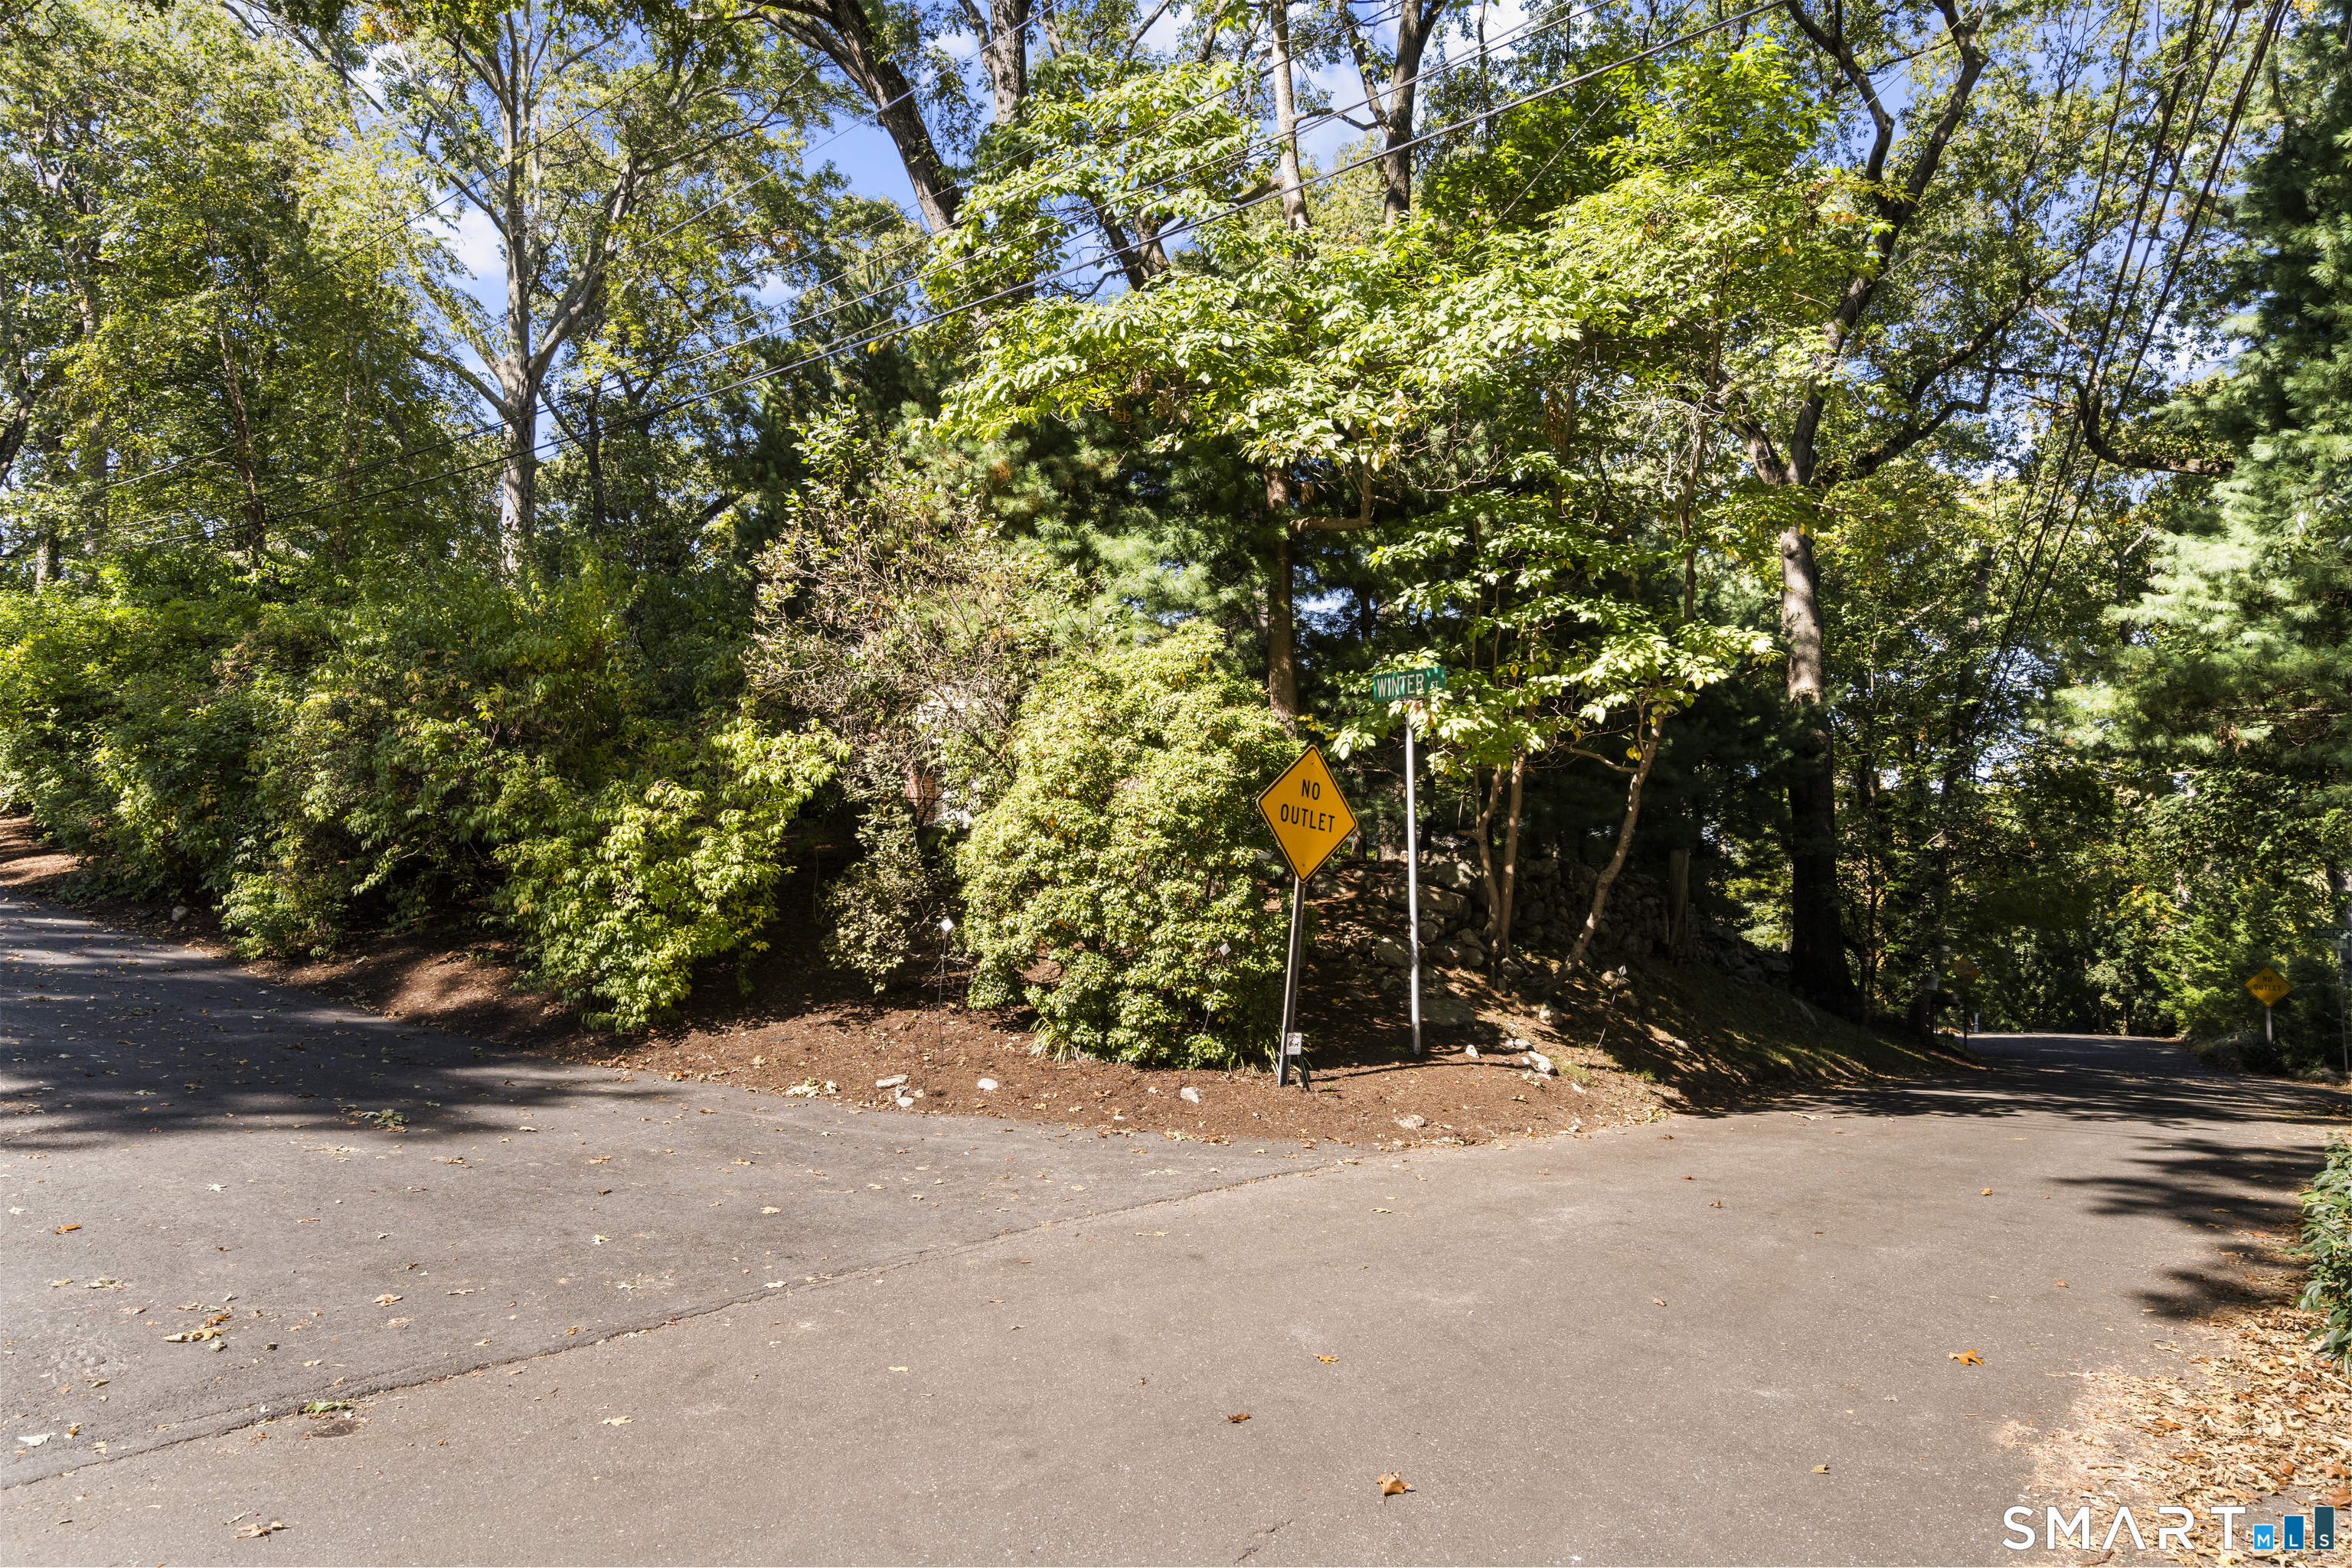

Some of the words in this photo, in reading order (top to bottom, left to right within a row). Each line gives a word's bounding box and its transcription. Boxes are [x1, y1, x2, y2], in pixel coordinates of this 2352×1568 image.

[1377, 673, 1425, 698] WINTER
[1430, 681, 1439, 689] ST
[1301, 779, 1321, 801] NO
[1280, 804, 1335, 833] OUTLET
